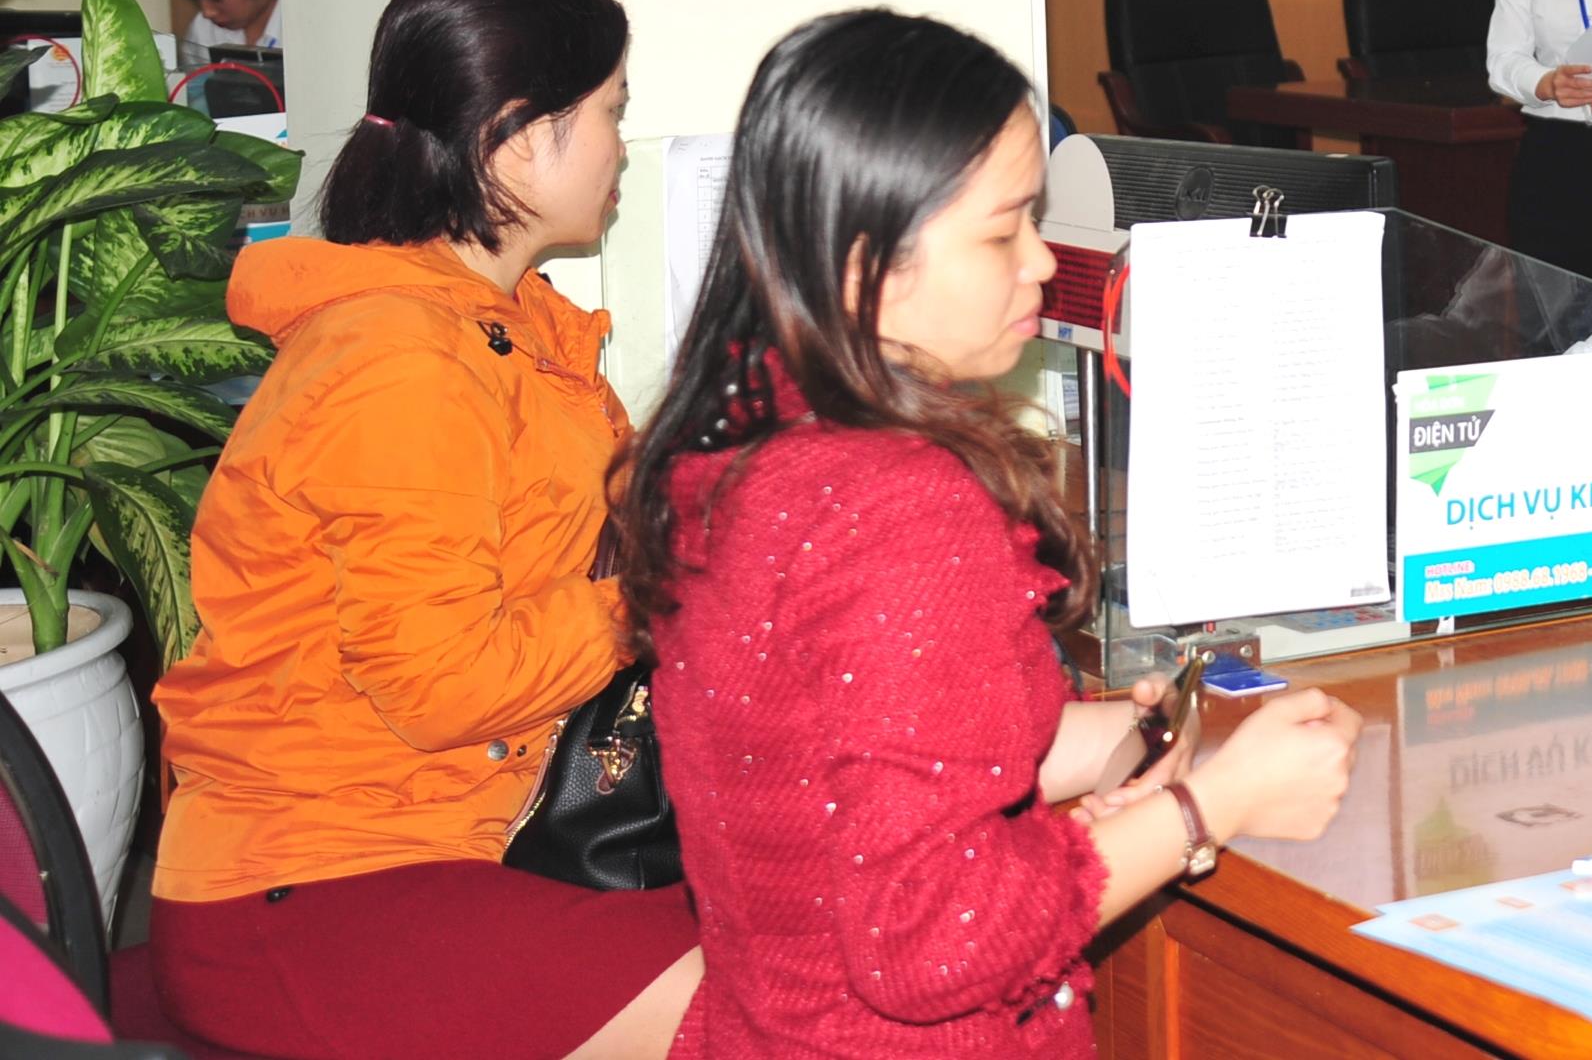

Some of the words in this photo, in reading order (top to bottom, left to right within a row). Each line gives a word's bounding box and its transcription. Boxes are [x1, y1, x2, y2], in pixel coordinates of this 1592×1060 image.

[1413, 420, 1455, 448] ĐIỆN
[1457, 414, 1482, 442] TỬ
[1447, 492, 1516, 531] DỊCH
[1523, 486, 1562, 520] VỤ
